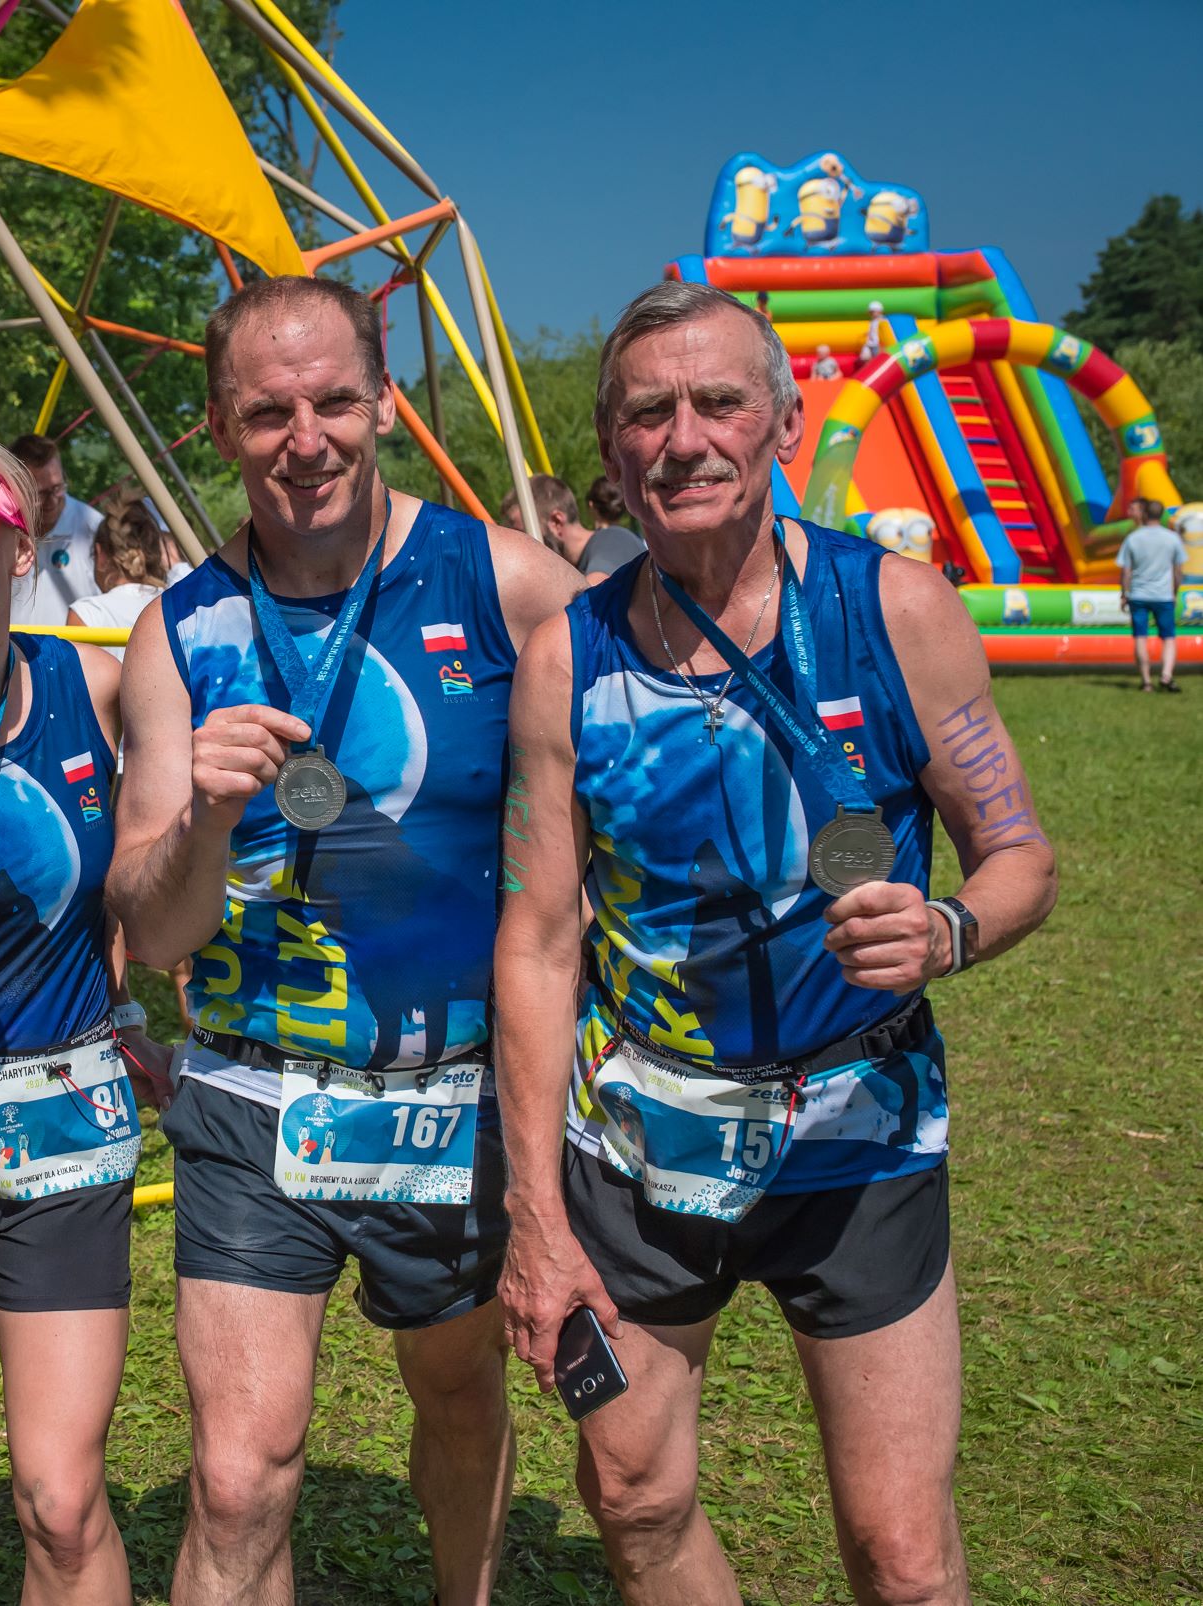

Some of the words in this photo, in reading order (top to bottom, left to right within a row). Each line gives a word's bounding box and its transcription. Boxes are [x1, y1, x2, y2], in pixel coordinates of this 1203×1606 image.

[291, 783, 328, 799] zeto
[441, 1070, 476, 1084] zeto
[732, 1065, 794, 1080] anti-shock
[91, 1081, 128, 1129] 84
[392, 1105, 461, 1149] 167
[718, 1120, 773, 1169] 15
[15, 1173, 44, 1187] BIEGNIEMY
[44, 1171, 55, 1180] DLA
[56, 1164, 83, 1176] ŁUKASZA
[284, 1171, 293, 1182] 10
[294, 1171, 306, 1182] KM
[310, 1174, 340, 1185] BIEGNIEMY
[341, 1176, 353, 1185] DLA
[354, 1175, 380, 1185] ŁUKASZA
[725, 1164, 761, 1187] Jerzy
